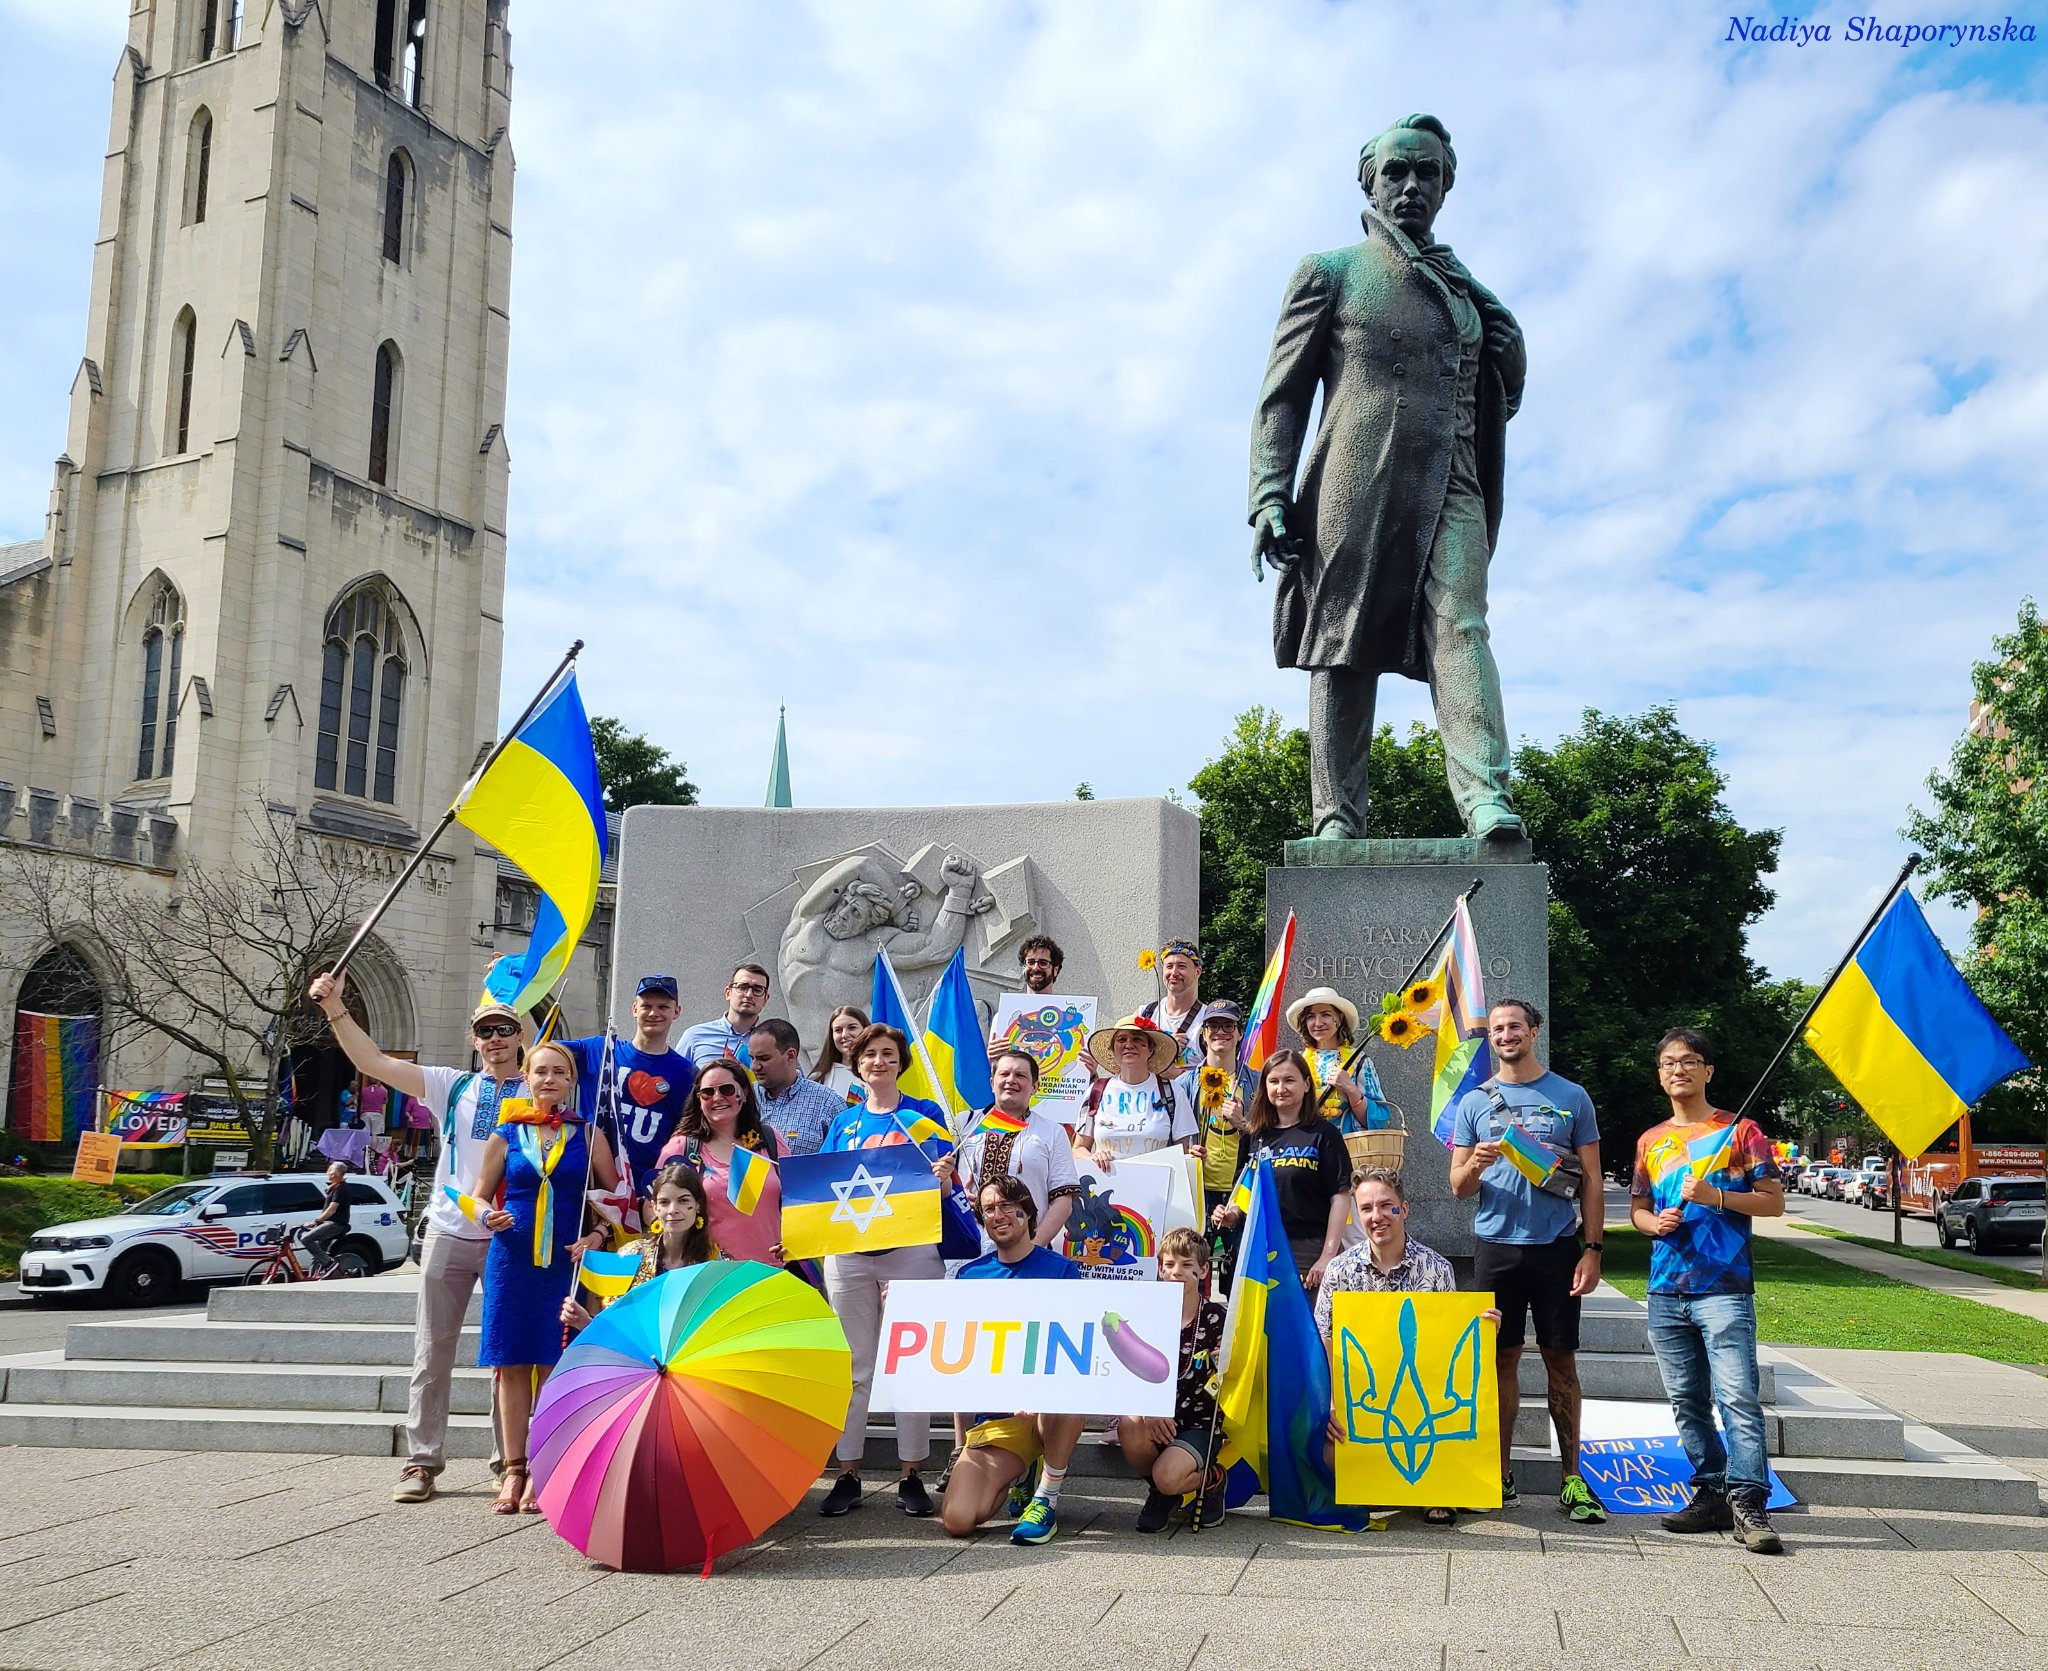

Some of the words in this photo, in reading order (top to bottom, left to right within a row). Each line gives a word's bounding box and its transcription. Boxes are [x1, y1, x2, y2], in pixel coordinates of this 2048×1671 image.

[1363, 926, 1446, 945] TARA
[1303, 956, 1511, 979] SHEVCHEO
[1042, 1088, 1086, 1096] COMMUNITY
[119, 1115, 181, 1131] LOVED
[209, 1121, 232, 1130] JUNE
[1127, 1118, 1147, 1132] of
[1253, 1147, 1319, 1161] LAVA
[1094, 1265, 1115, 1273] WITH
[1116, 1267, 1127, 1275] US
[884, 1321, 1095, 1376] PUTIN
[1094, 1356, 1111, 1377] is
[1644, 1439, 1665, 1450] IS
[1582, 1454, 1669, 1482] WAR
